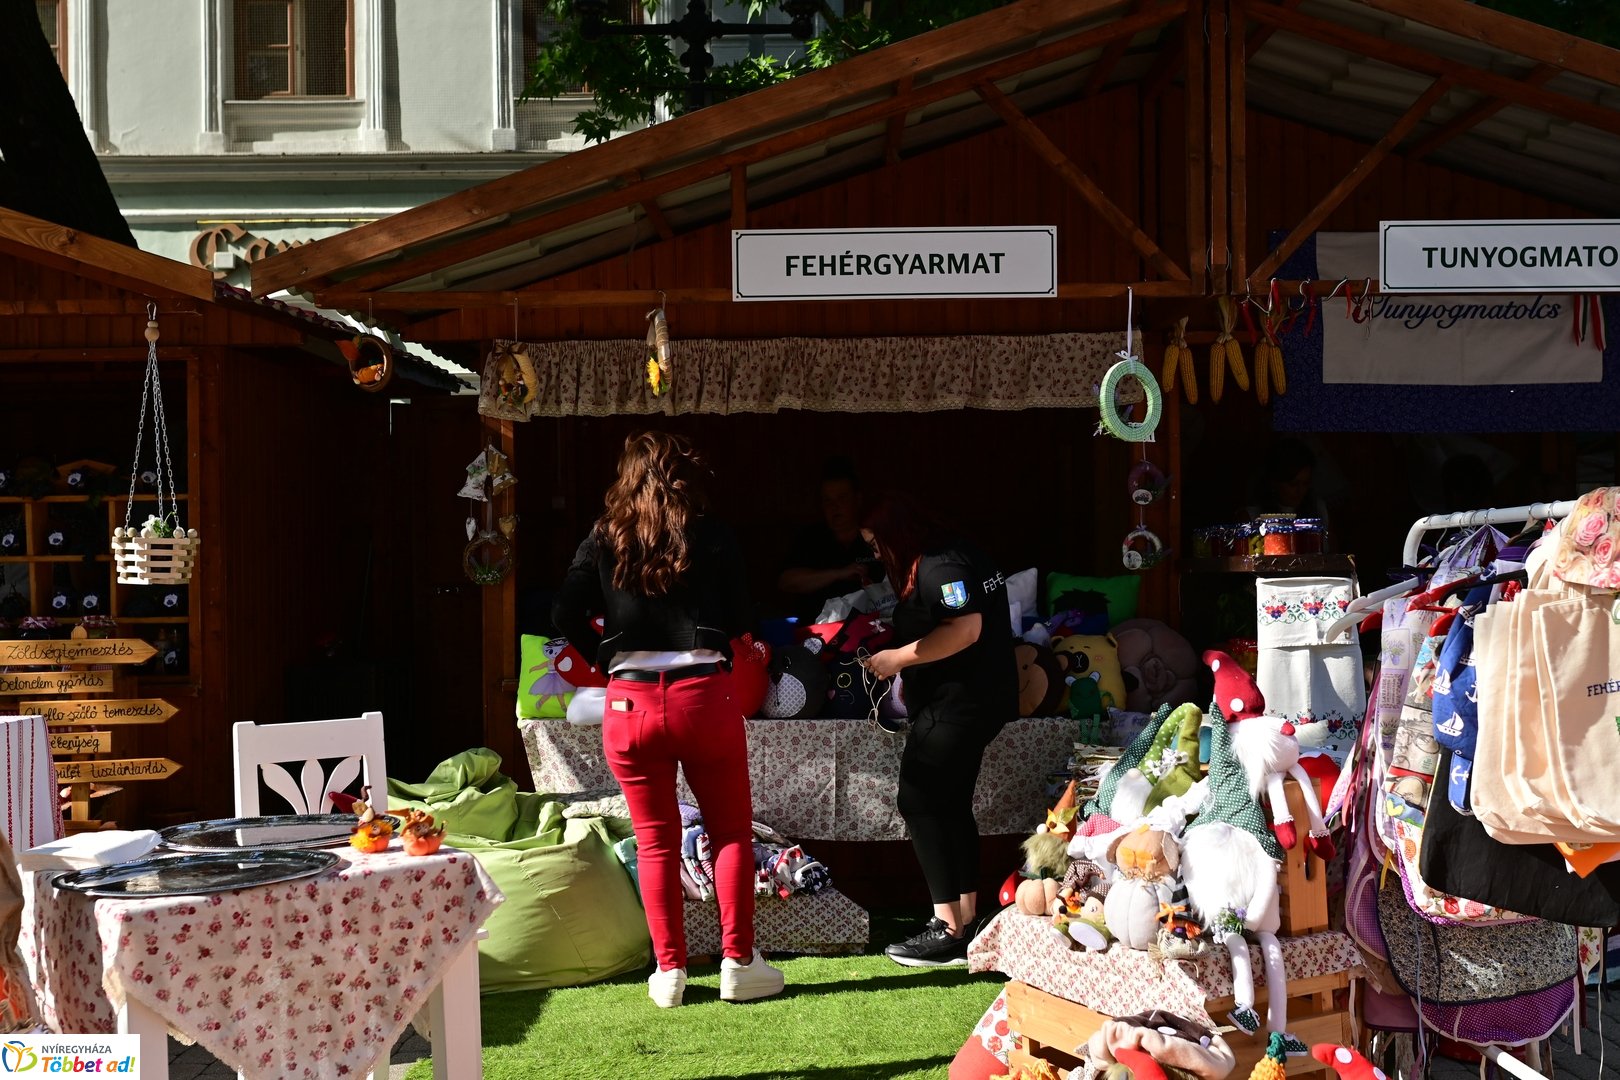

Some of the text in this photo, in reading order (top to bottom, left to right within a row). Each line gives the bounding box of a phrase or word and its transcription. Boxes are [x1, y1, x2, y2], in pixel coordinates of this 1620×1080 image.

[785, 251, 1006, 277] FEHÉRGYARMAT
[1422, 245, 1619, 269] TUNYOGMATO
[1364, 295, 1562, 330] Tunyogmatolcs
[6, 643, 134, 664] Zöldségtermesztés
